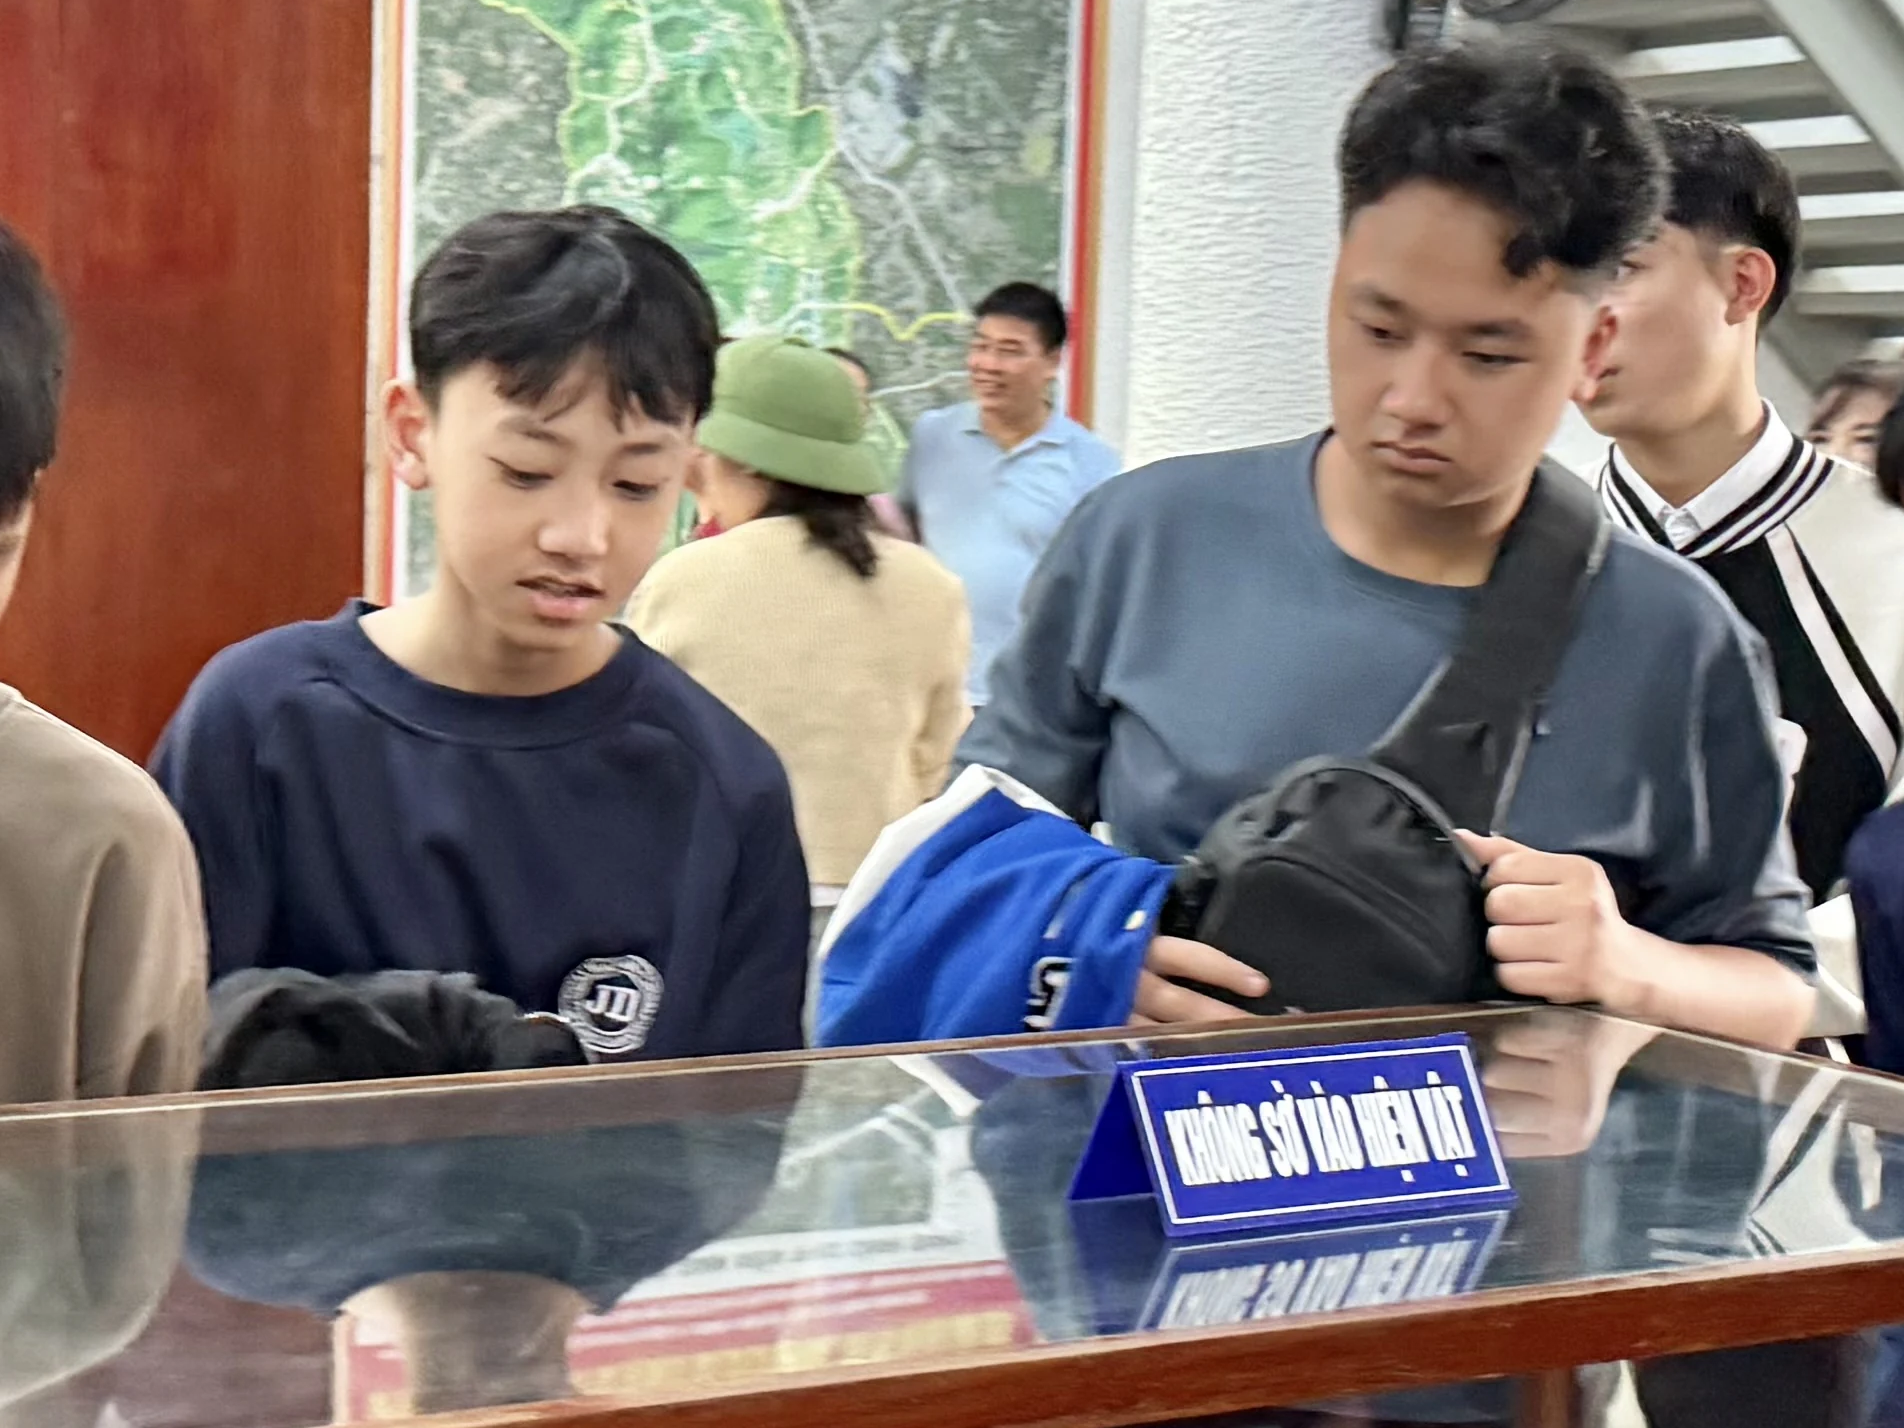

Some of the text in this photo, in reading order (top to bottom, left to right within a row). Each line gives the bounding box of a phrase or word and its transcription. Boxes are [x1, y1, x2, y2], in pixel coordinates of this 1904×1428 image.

[1163, 1070, 1477, 1187] KHÔNG SỜ VÀO HIỆN VẬT
